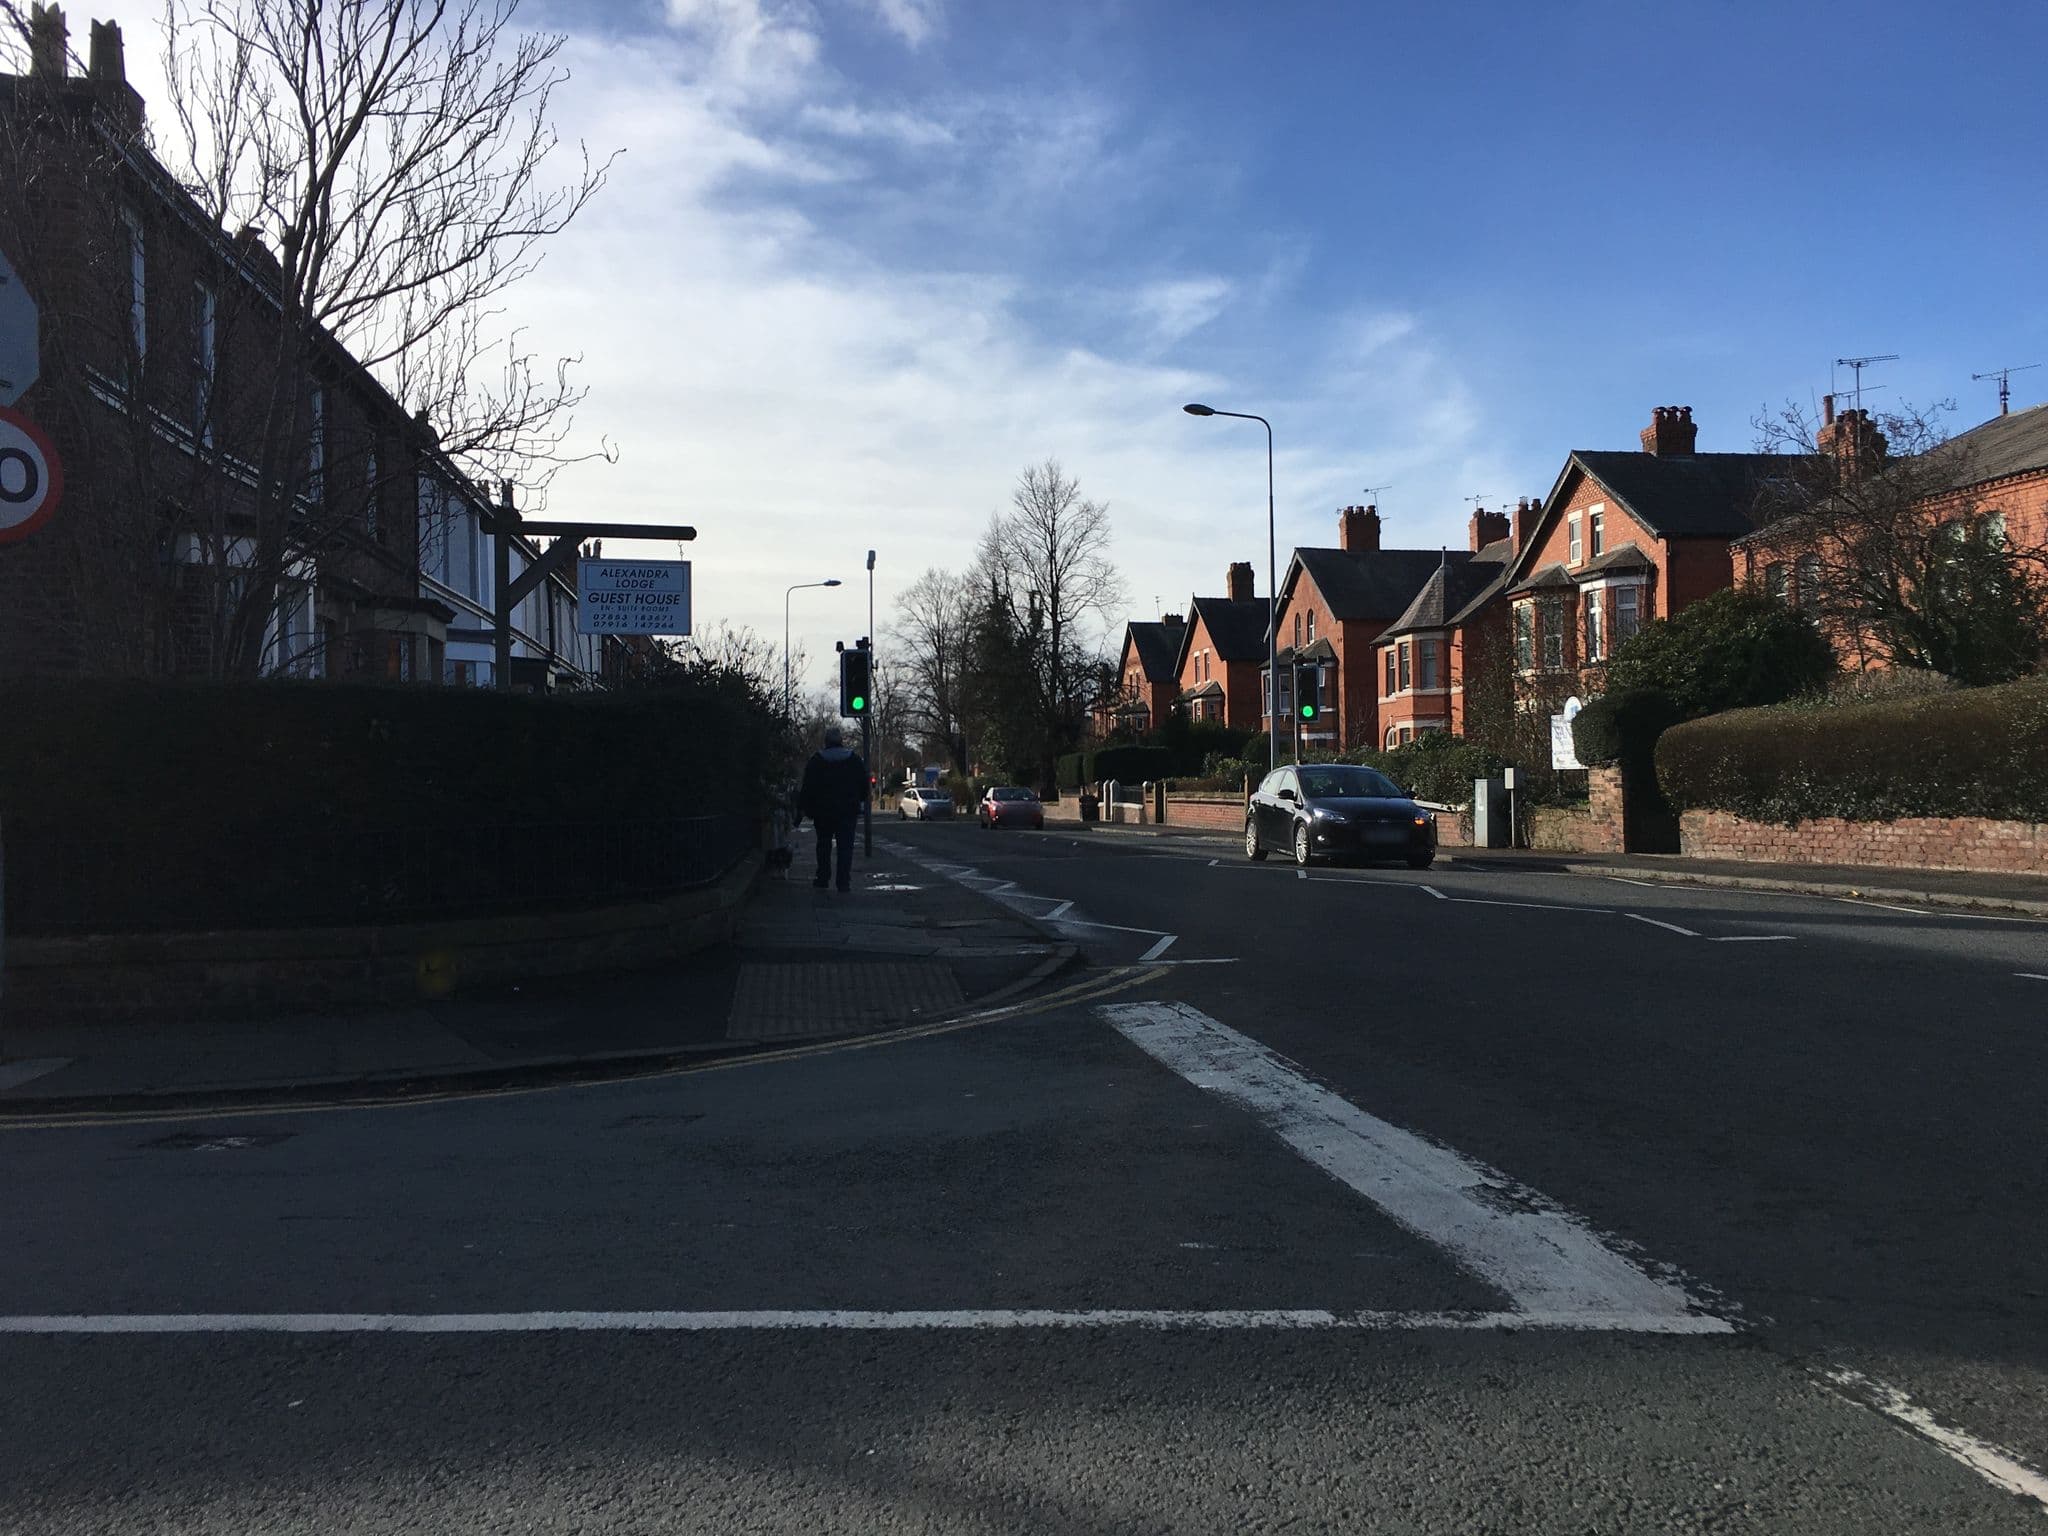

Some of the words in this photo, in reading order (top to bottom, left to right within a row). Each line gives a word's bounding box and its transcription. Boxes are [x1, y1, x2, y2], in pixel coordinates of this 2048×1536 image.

[0, 447, 39, 503] 0
[600, 568, 670, 579] ALEXANDRA
[616, 579, 656, 589] LODGE
[588, 592, 632, 604] GUEST
[634, 593, 681, 605] HOUSE
